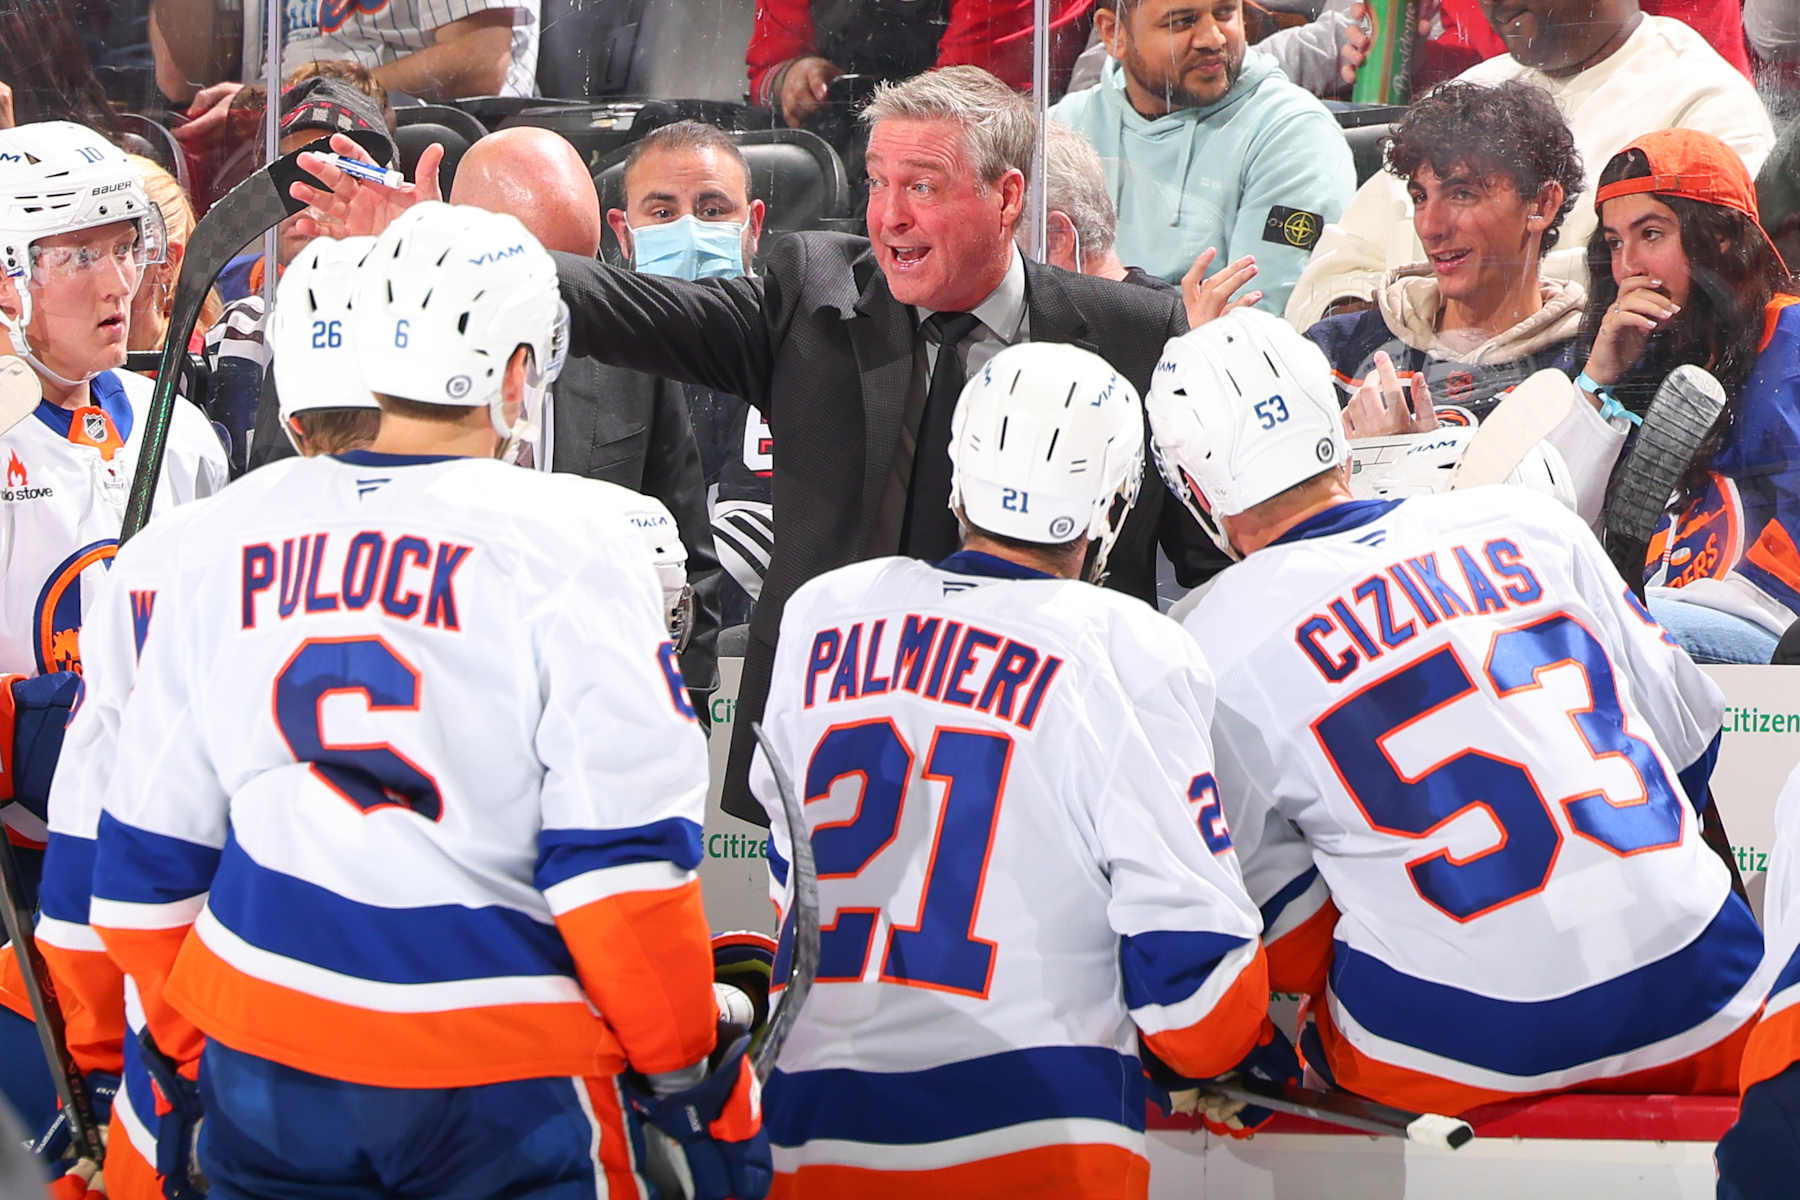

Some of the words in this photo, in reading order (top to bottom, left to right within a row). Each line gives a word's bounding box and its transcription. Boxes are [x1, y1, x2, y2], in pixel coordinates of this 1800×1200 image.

[75, 147, 105, 163] 10
[468, 244, 524, 265] VIAM
[312, 320, 342, 349] 26
[394, 319, 410, 348] 6
[1254, 394, 1290, 430] 53
[16, 487, 54, 501] stove
[1002, 487, 1030, 514] 21
[241, 531, 474, 632] PULOCK
[1295, 537, 1544, 684] CIZIKAS
[803, 613, 1065, 732] PALMIERI
[272, 634, 443, 824] 6
[1310, 610, 1685, 924] 53
[770, 716, 1015, 1000] 21
